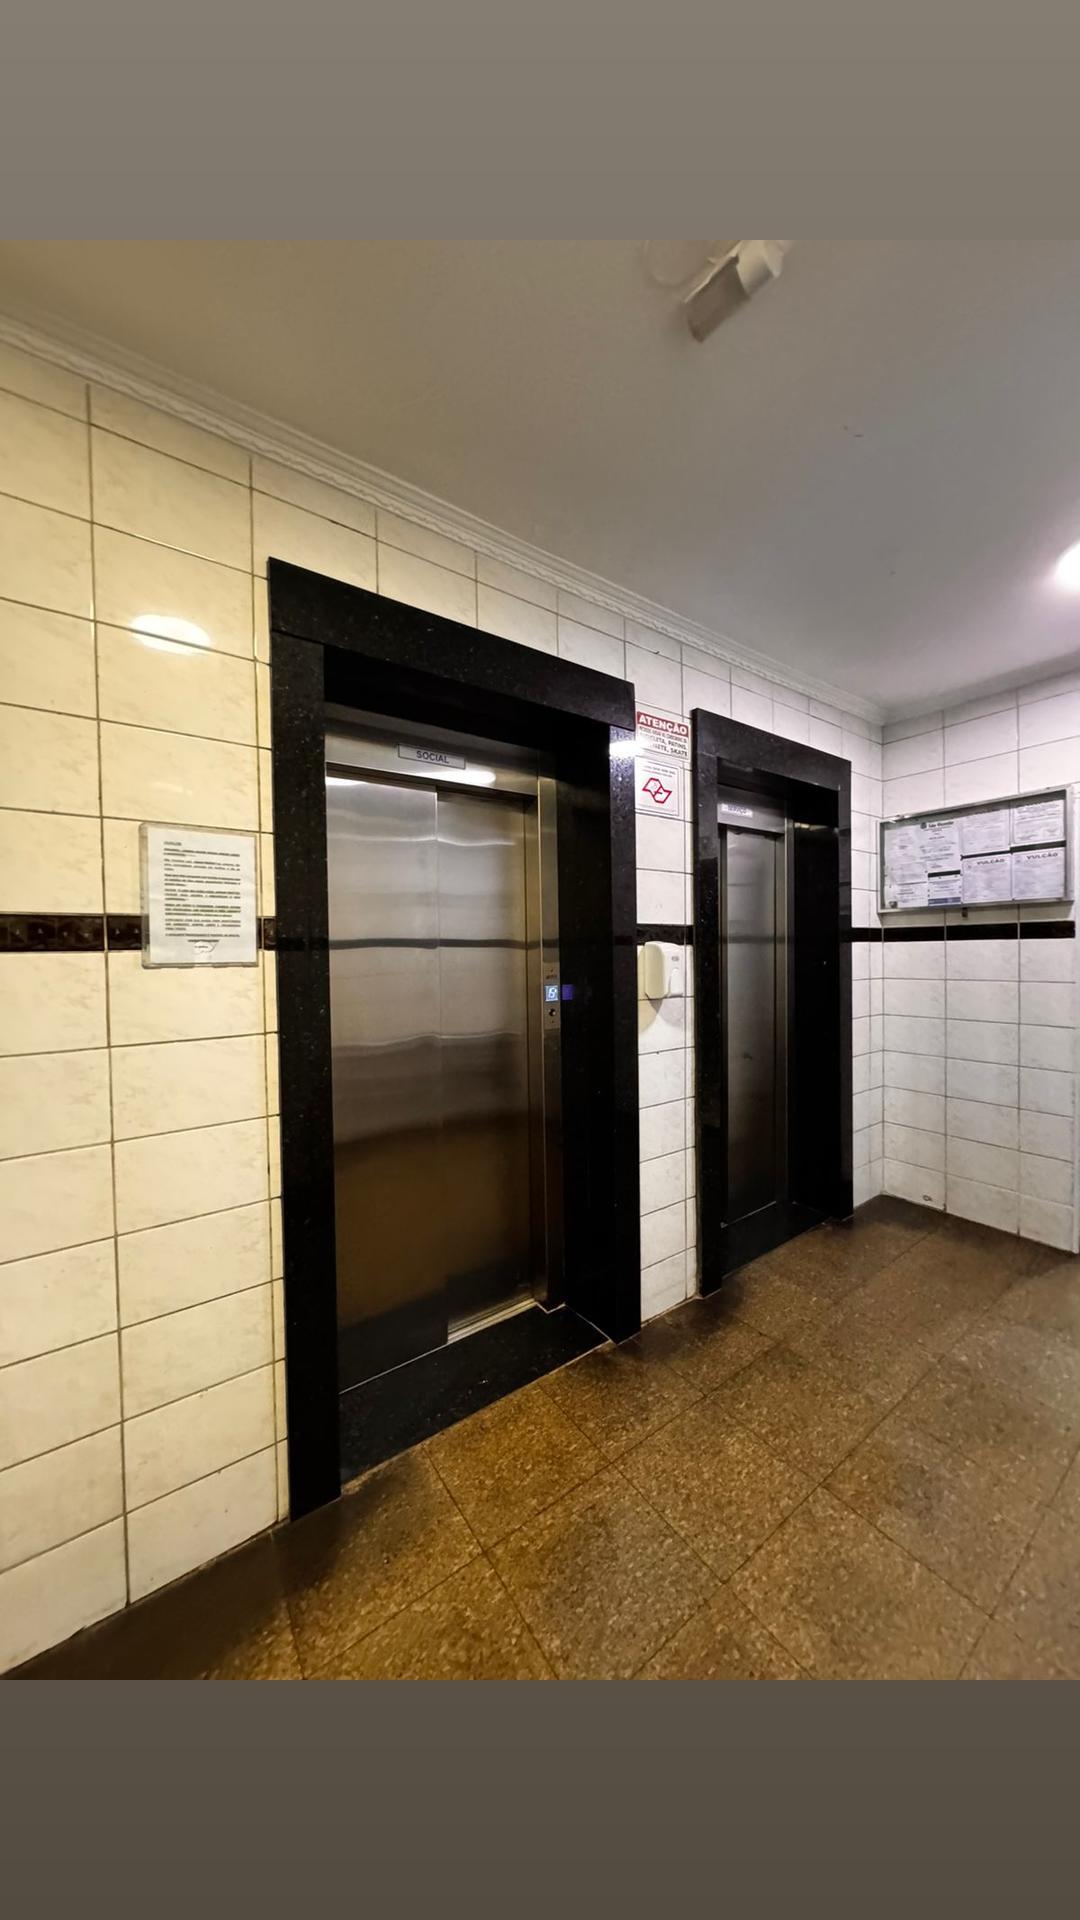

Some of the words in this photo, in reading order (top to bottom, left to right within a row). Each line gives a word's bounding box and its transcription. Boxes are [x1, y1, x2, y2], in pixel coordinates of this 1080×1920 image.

[639, 713, 688, 735] ATENÇÃO
[416, 750, 450, 764] SOCIAL
[670, 747, 688, 757] SKATE
